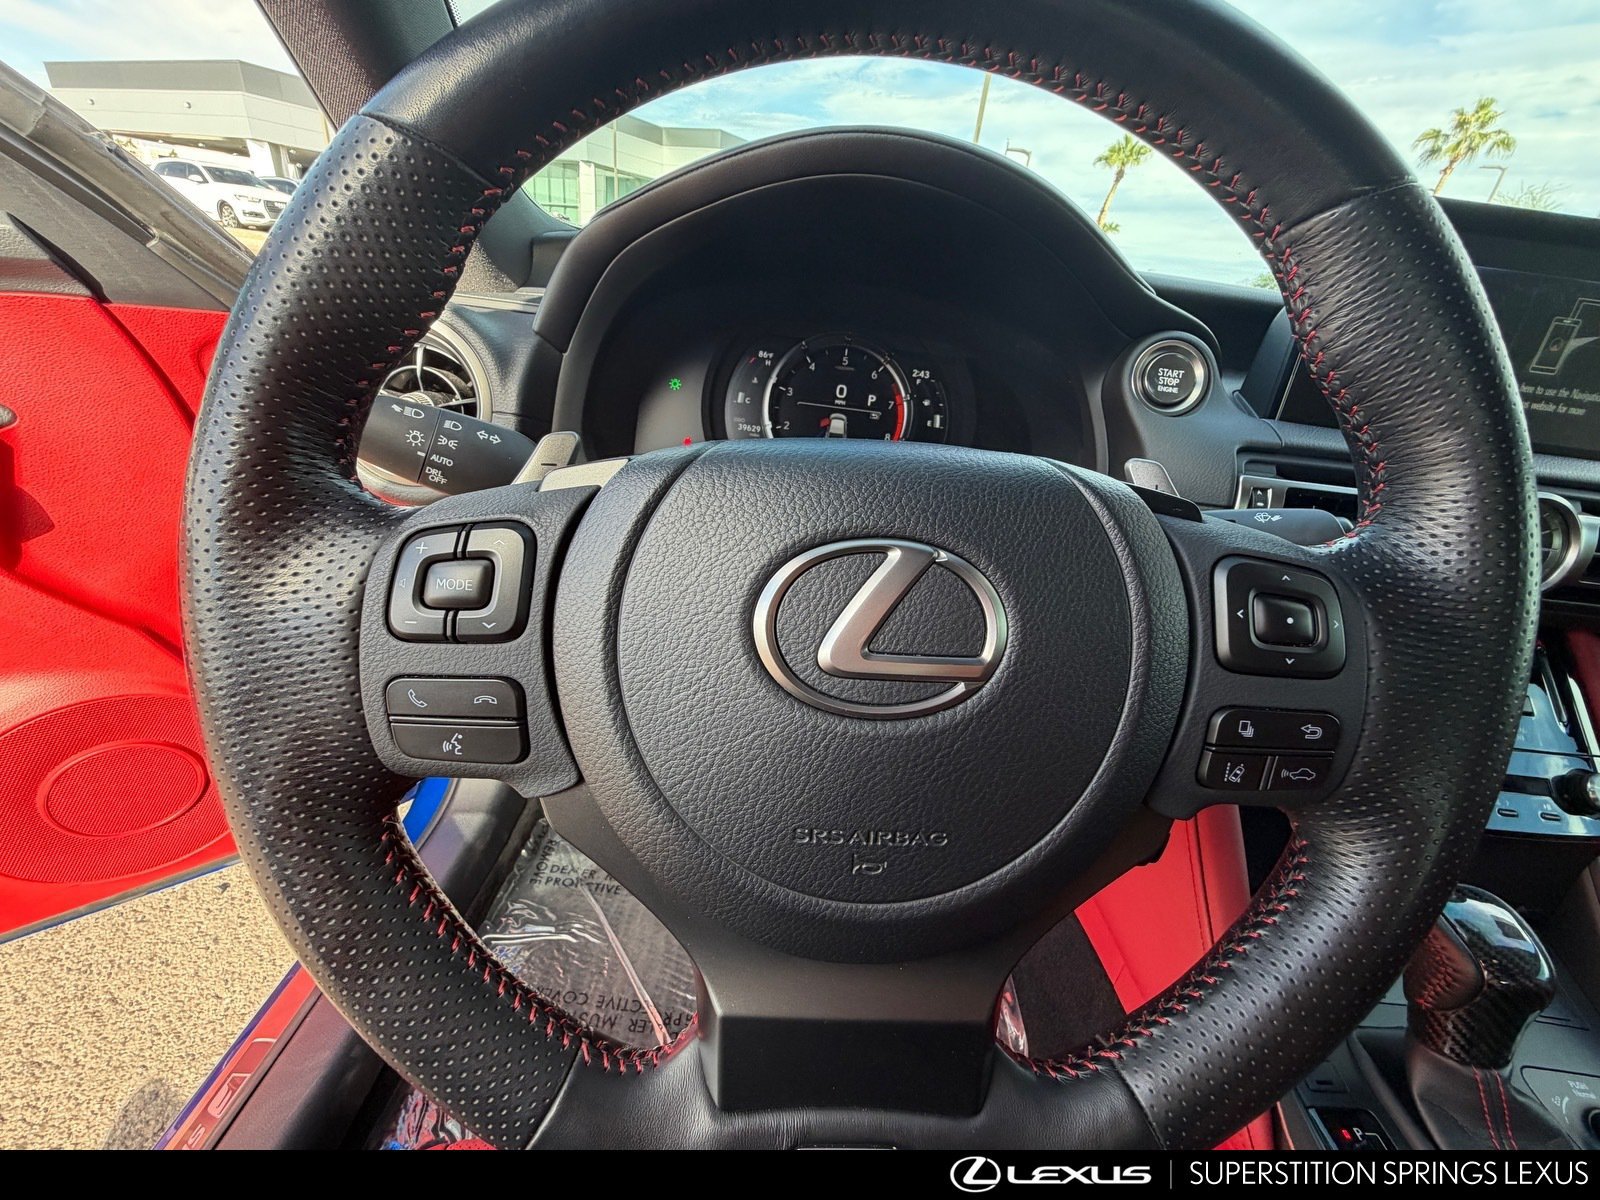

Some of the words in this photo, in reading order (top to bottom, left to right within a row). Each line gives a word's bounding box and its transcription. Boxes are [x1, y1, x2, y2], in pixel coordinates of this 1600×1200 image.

[842, 356, 849, 366] 5
[809, 362, 816, 371] 4
[871, 371, 878, 380] 6
[912, 369, 930, 379] 2:43
[1158, 368, 1184, 378] START
[1159, 377, 1179, 386] STOP
[786, 387, 793, 396] 3
[836, 384, 848, 399] 0
[1158, 385, 1178, 393] ENGINE
[867, 394, 877, 406] P
[888, 400, 894, 410] 7
[737, 423, 761, 433] 39629
[783, 421, 790, 430] 2
[430, 453, 454, 467] AUTO
[425, 466, 444, 478] DRL
[428, 474, 448, 485] OFF
[435, 578, 473, 591] MODE
[793, 827, 844, 845] SRS
[849, 829, 949, 847] AIRBAG
[1352, 1127, 1363, 1141] P
